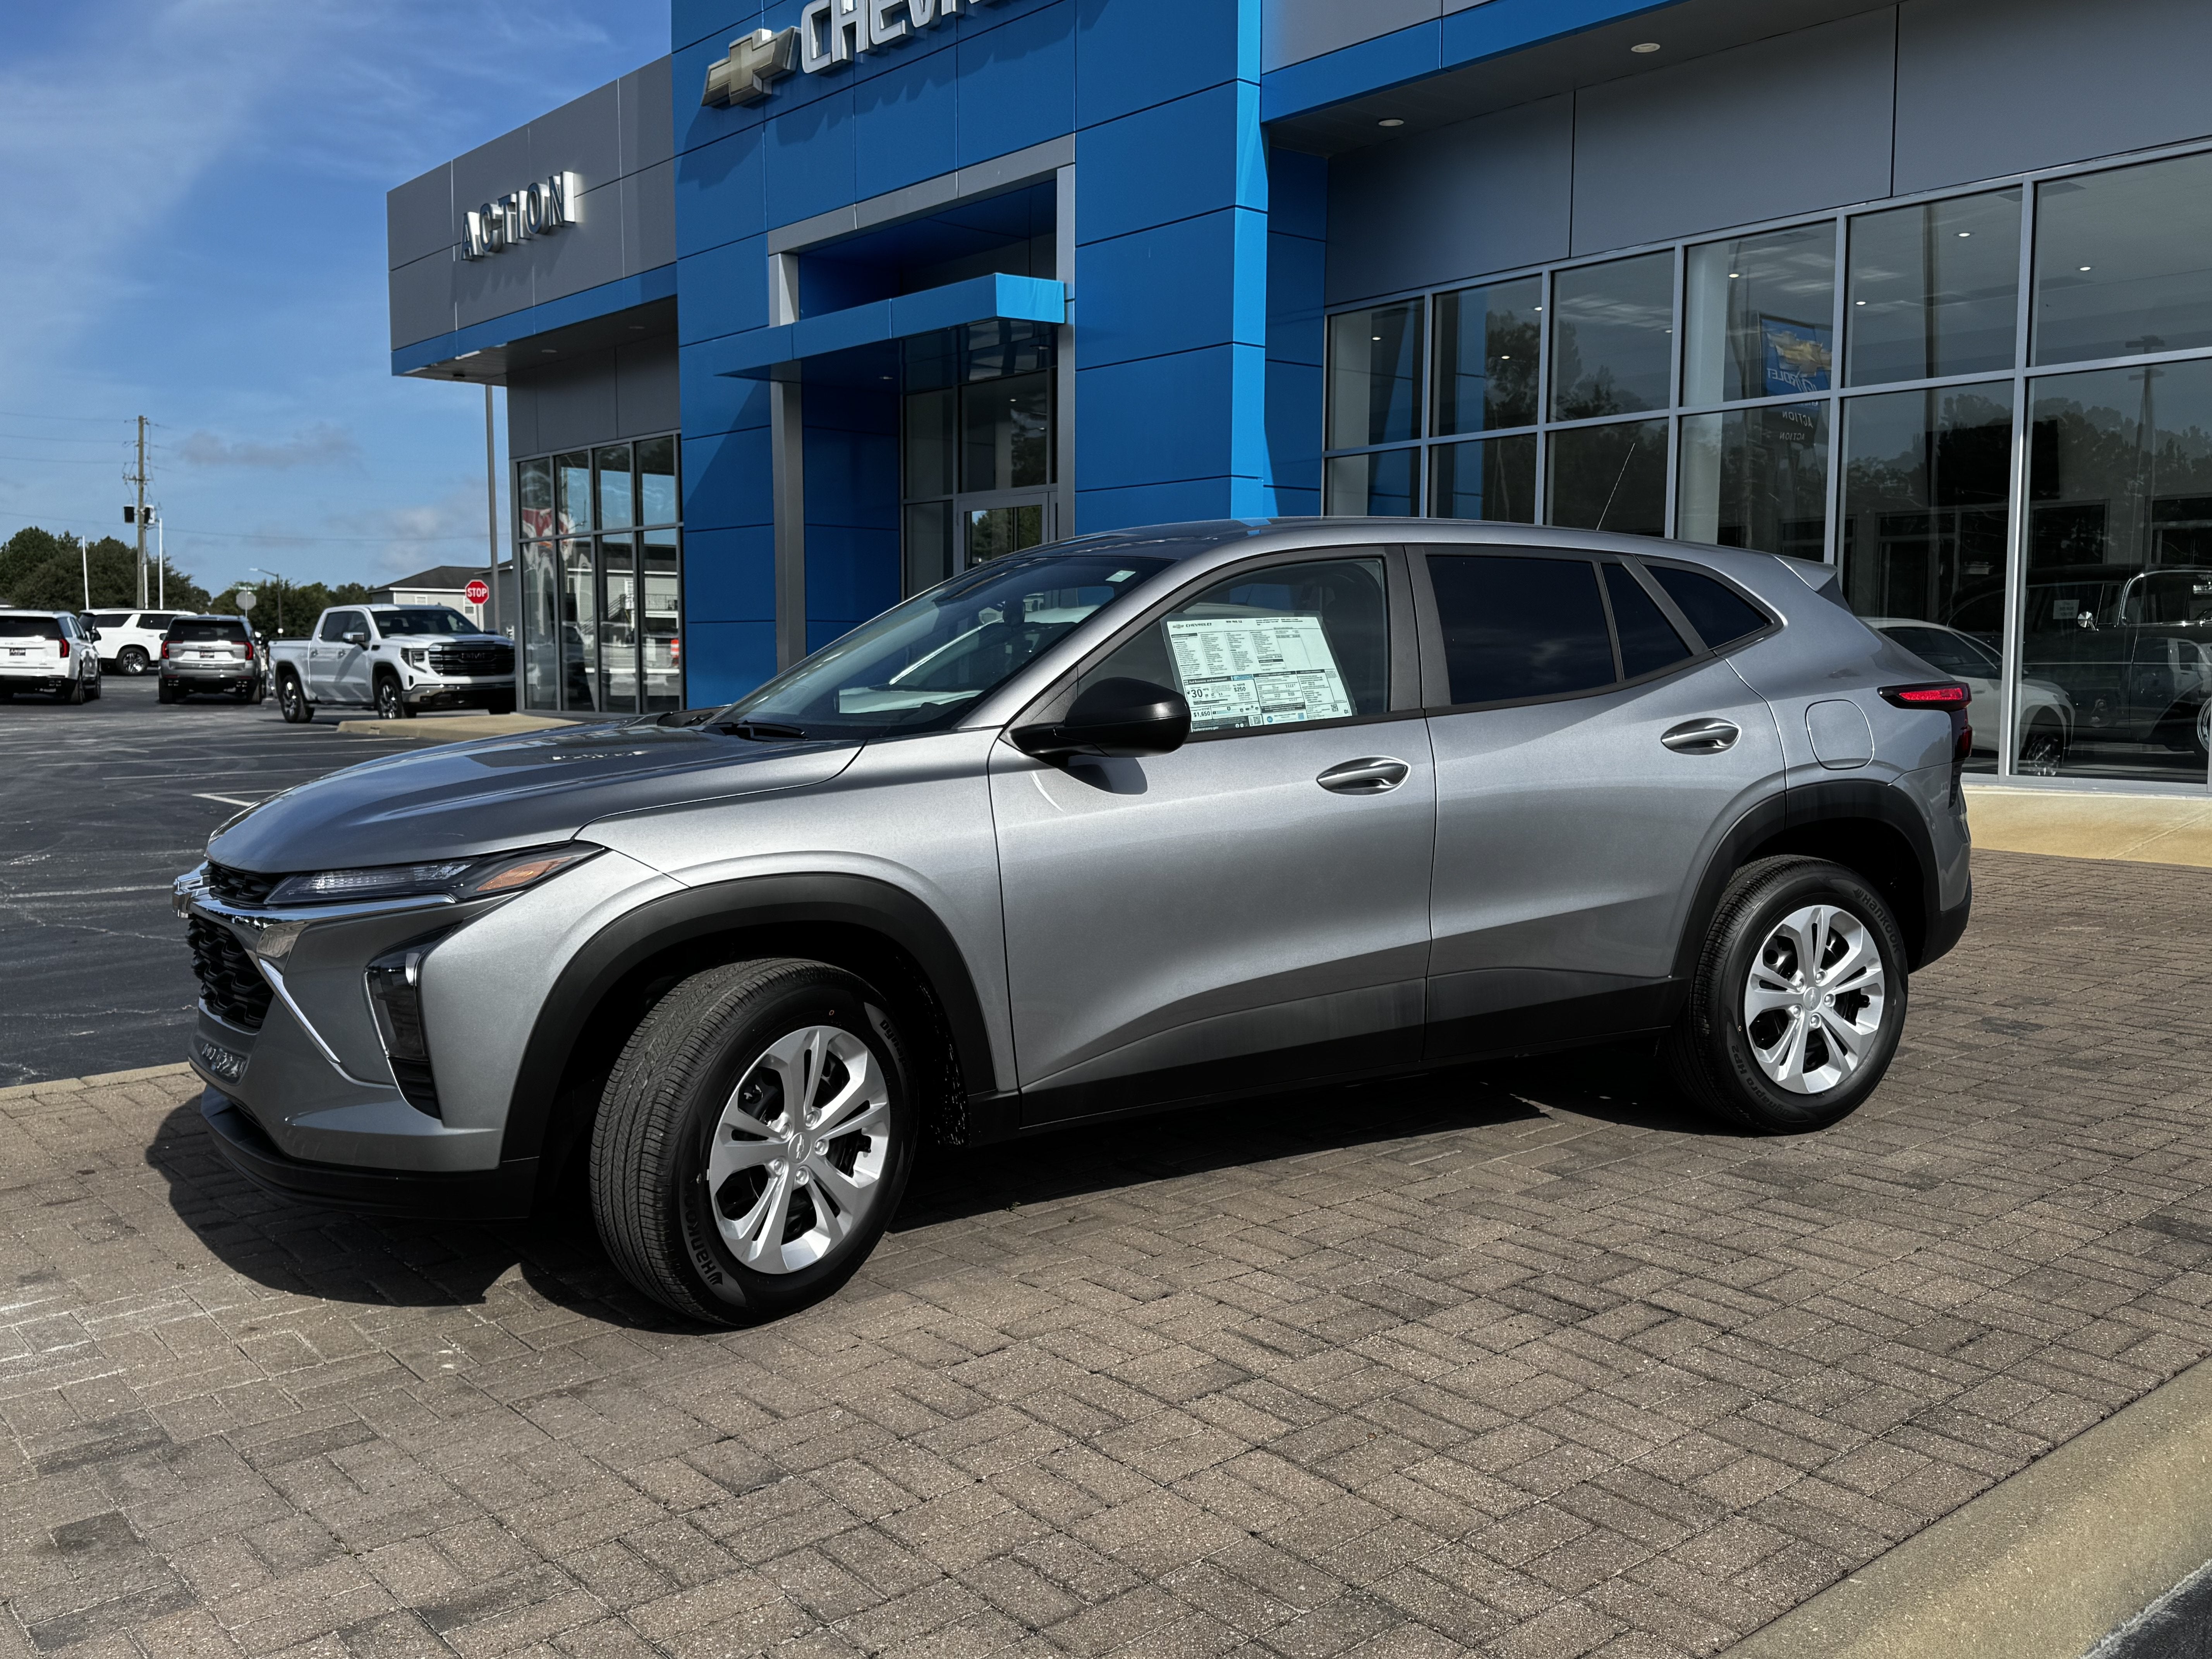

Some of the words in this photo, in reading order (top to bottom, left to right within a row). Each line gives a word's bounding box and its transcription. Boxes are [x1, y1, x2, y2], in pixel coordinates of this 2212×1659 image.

[460, 171, 575, 261] ACTION
[467, 587, 487, 597] STOP
[1191, 689, 1203, 698] 30
[1731, 1044, 1748, 1075] HP2
